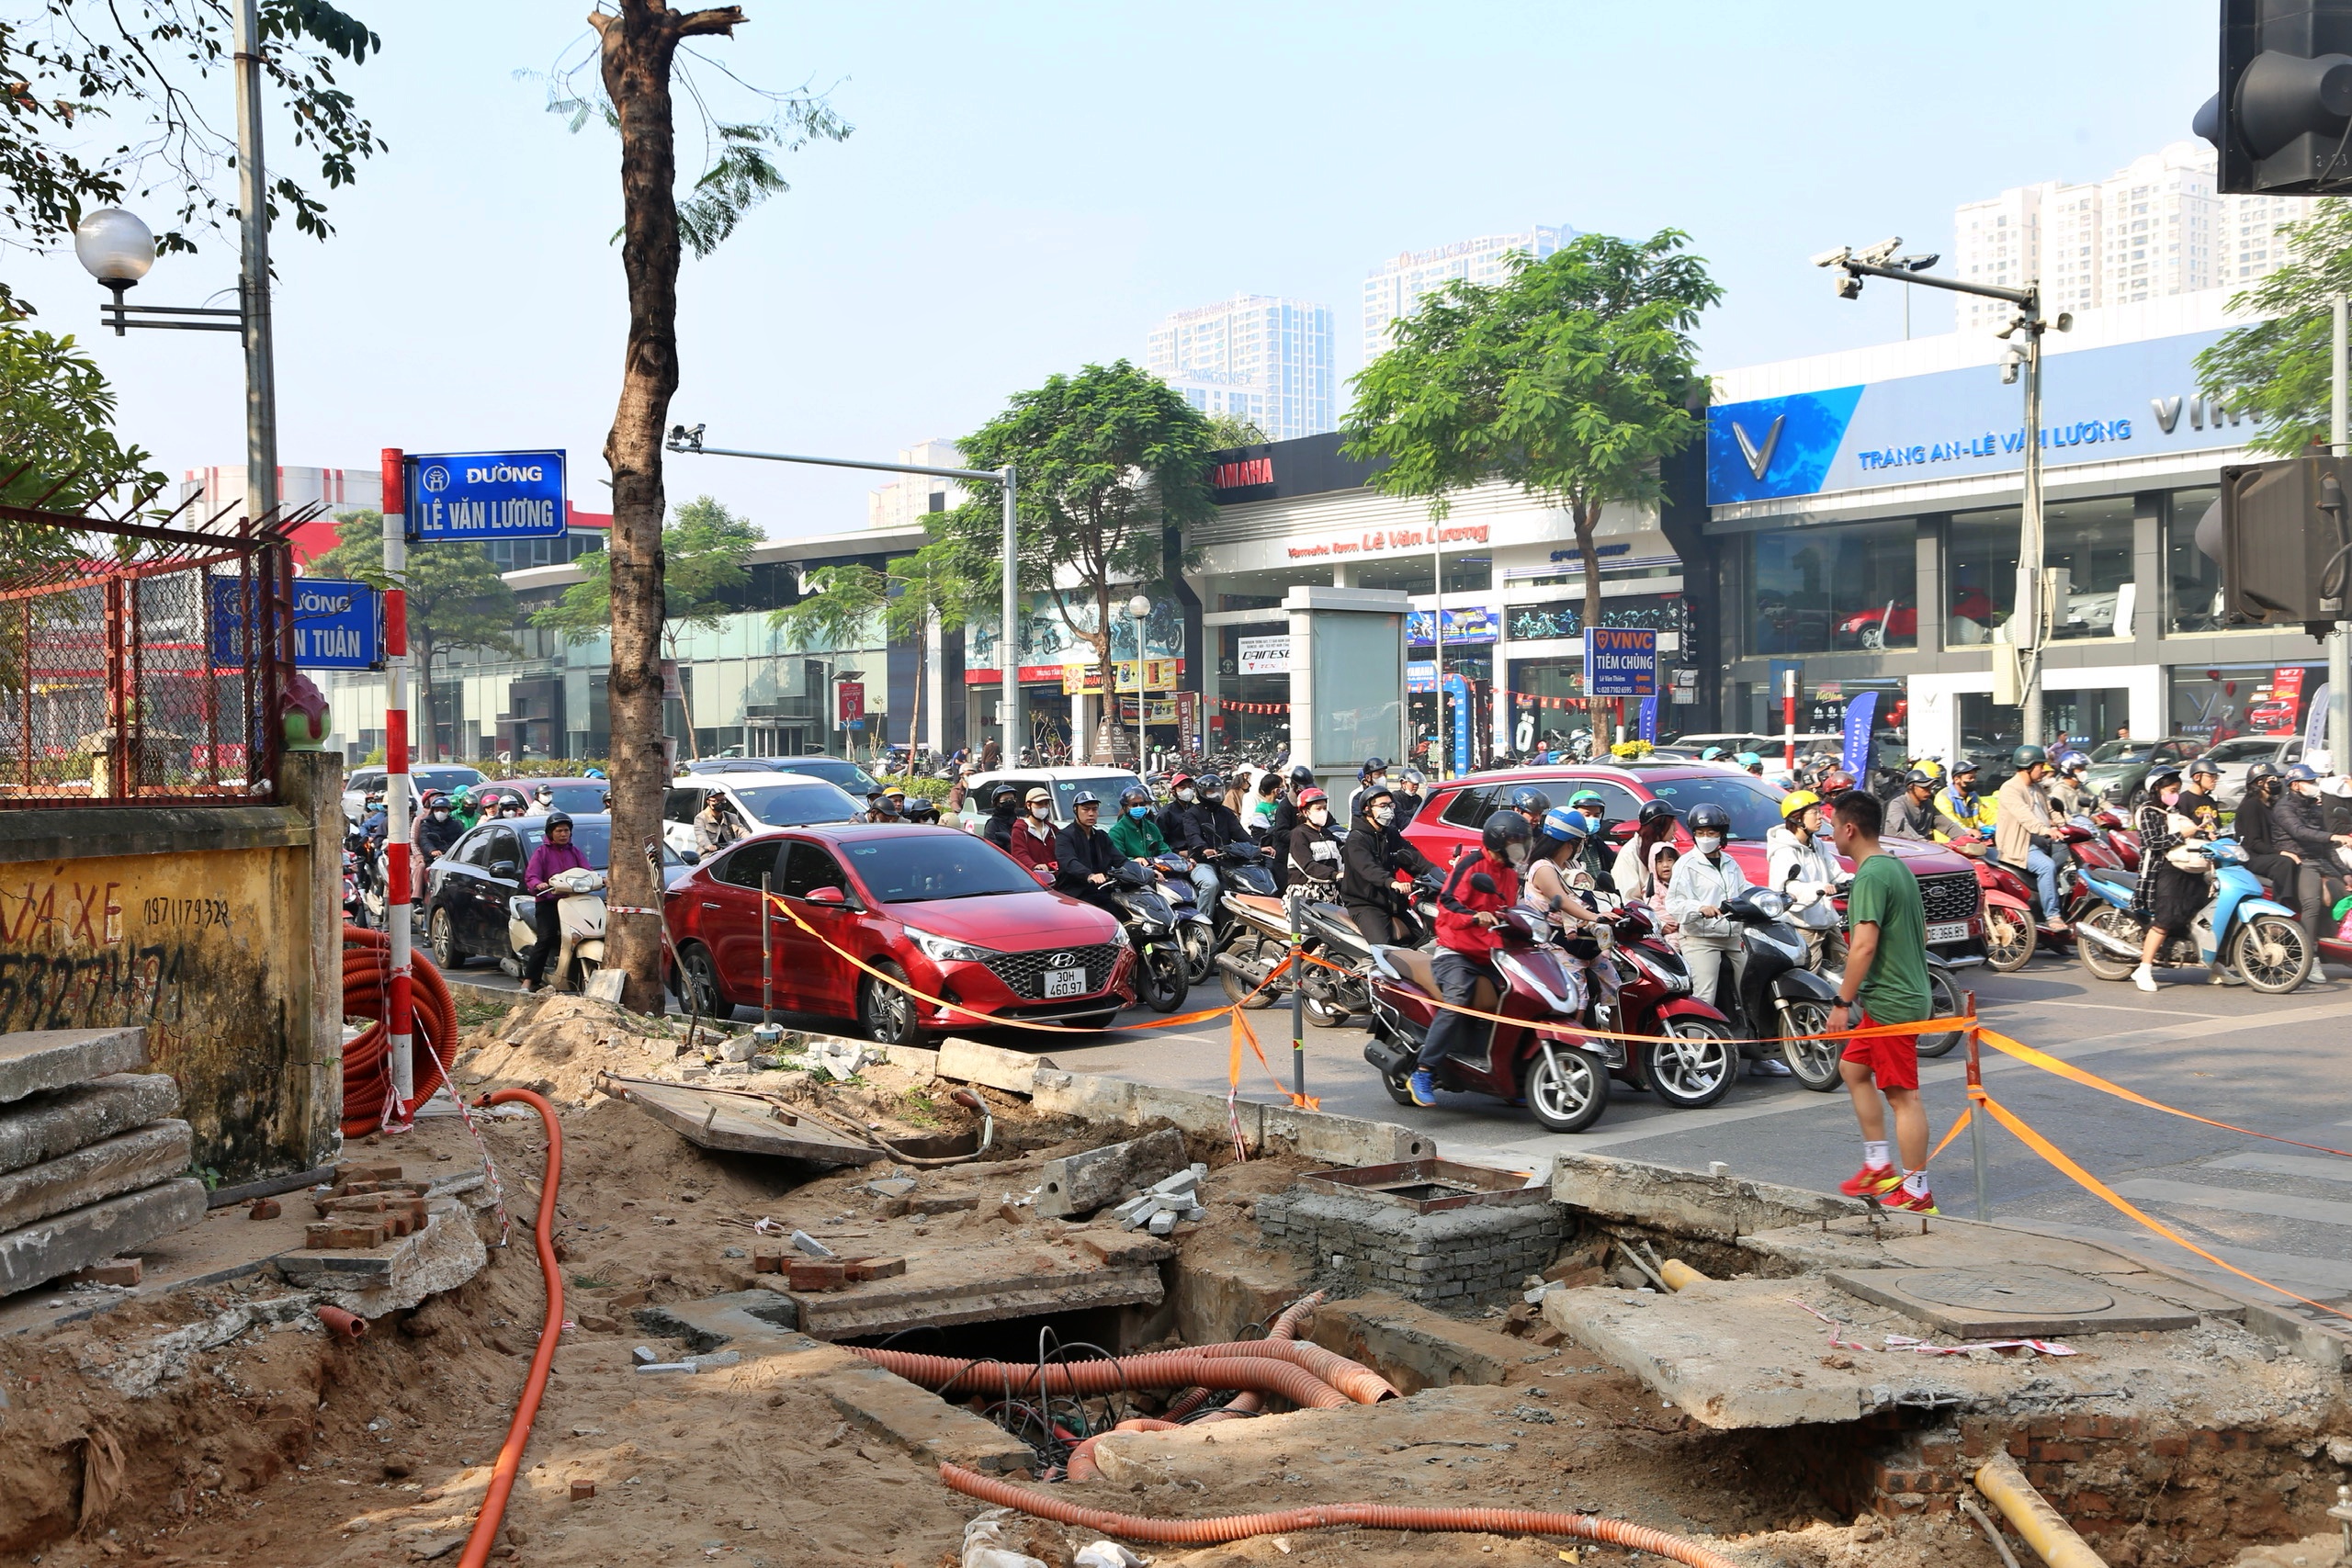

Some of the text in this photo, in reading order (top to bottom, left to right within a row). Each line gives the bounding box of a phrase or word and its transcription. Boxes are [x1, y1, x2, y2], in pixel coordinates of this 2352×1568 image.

[1180, 367, 1252, 386] VINACONEX
[2053, 419, 2132, 447] LƯƠNG
[466, 462, 543, 484] ĐƯỜNG
[1208, 457, 1273, 489] AMAHA
[422, 497, 554, 531] LÊ VĂN LƯƠNG
[1287, 544, 1329, 558] Yamaha
[1362, 531, 1385, 551] Lê
[1388, 530, 1423, 548] Văn
[1426, 525, 1490, 544] Lương
[276, 590, 352, 613] ƯỜNG
[312, 625, 360, 659] TUÂN
[1611, 632, 1653, 649] VNVC
[1242, 649, 1290, 660] DAINESE
[1596, 653, 1653, 670] TIÊM CHỦNG
[1407, 666, 1434, 676] YAMAHA
[1181, 716, 1192, 750] MOTOR
[1057, 971, 1075, 983] 30H
[1050, 982, 1082, 997] 460.97
